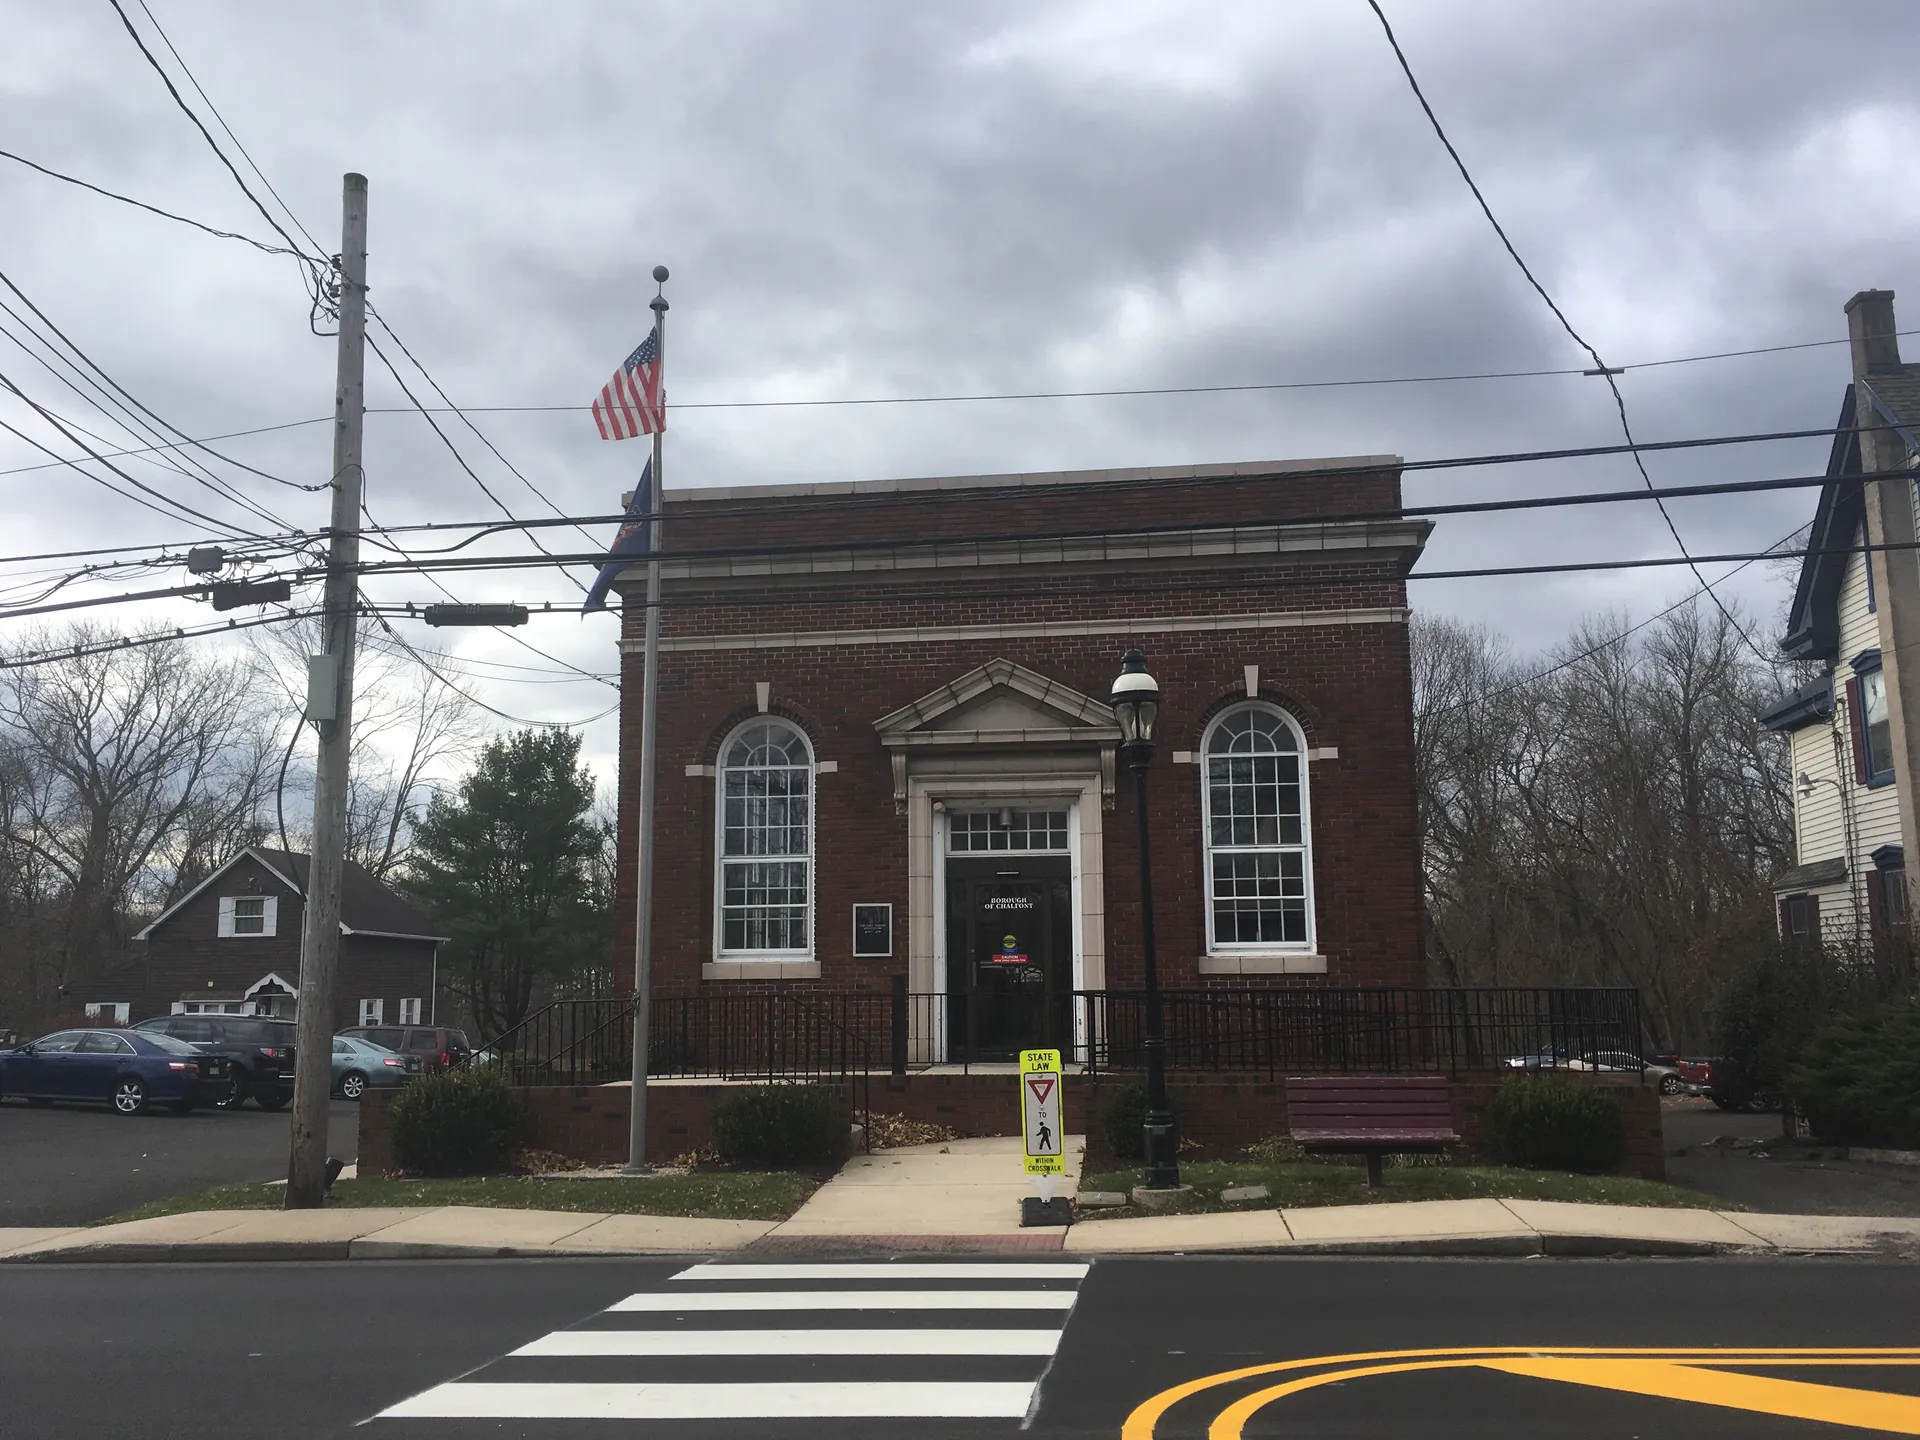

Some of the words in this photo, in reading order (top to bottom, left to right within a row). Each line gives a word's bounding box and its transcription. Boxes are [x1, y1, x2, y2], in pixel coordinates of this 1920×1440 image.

[1027, 1053, 1054, 1062] STATE
[1031, 1062, 1050, 1071] LAW
[1038, 1111, 1047, 1119] TO
